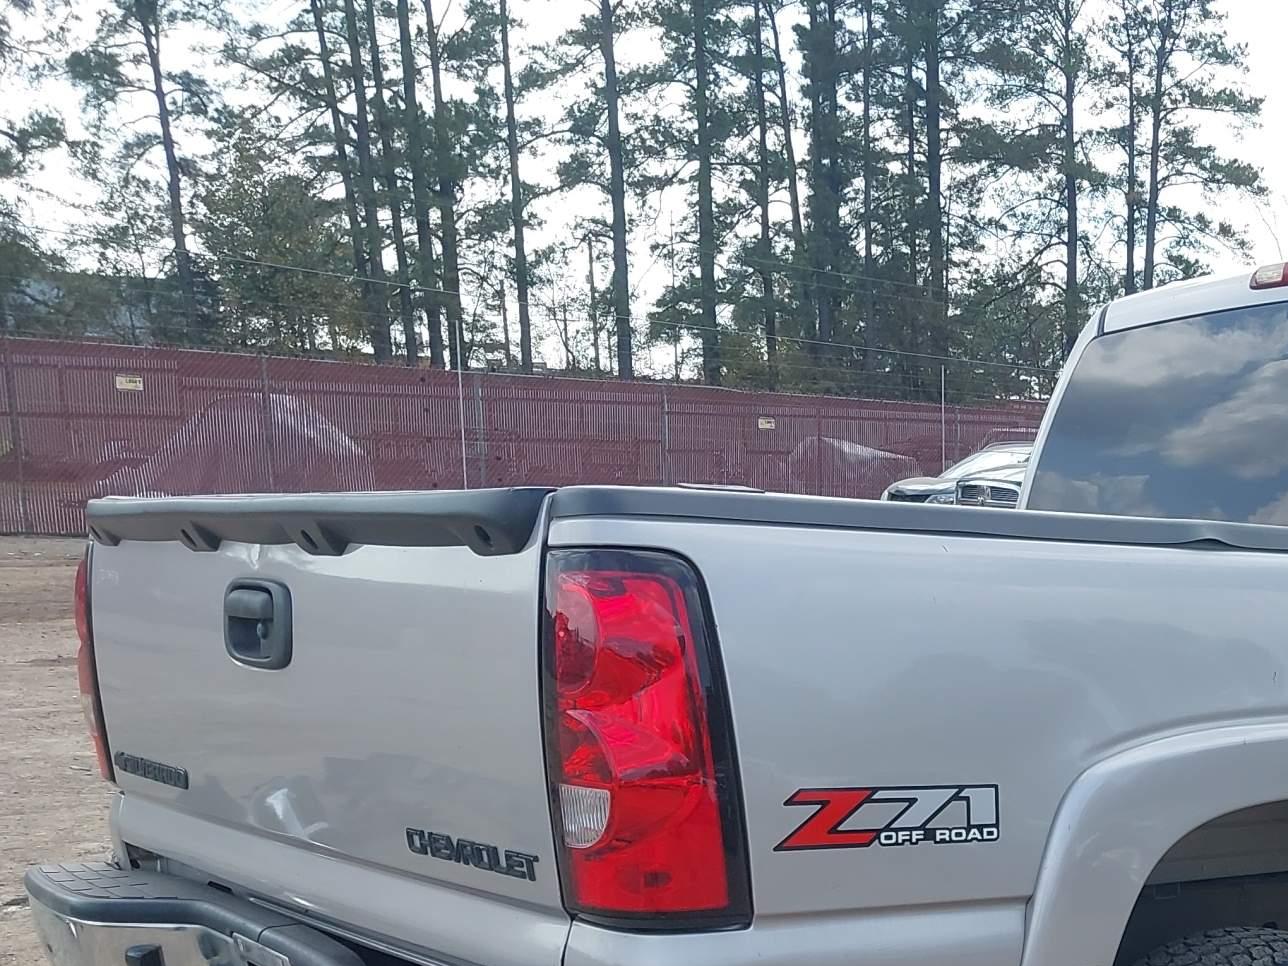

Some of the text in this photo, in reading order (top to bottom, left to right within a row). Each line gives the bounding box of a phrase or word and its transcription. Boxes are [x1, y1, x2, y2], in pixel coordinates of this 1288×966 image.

[773, 784, 999, 851] Z71
[879, 827, 998, 846] OFF ROAD
[405, 827, 539, 882] CHEVROLET
